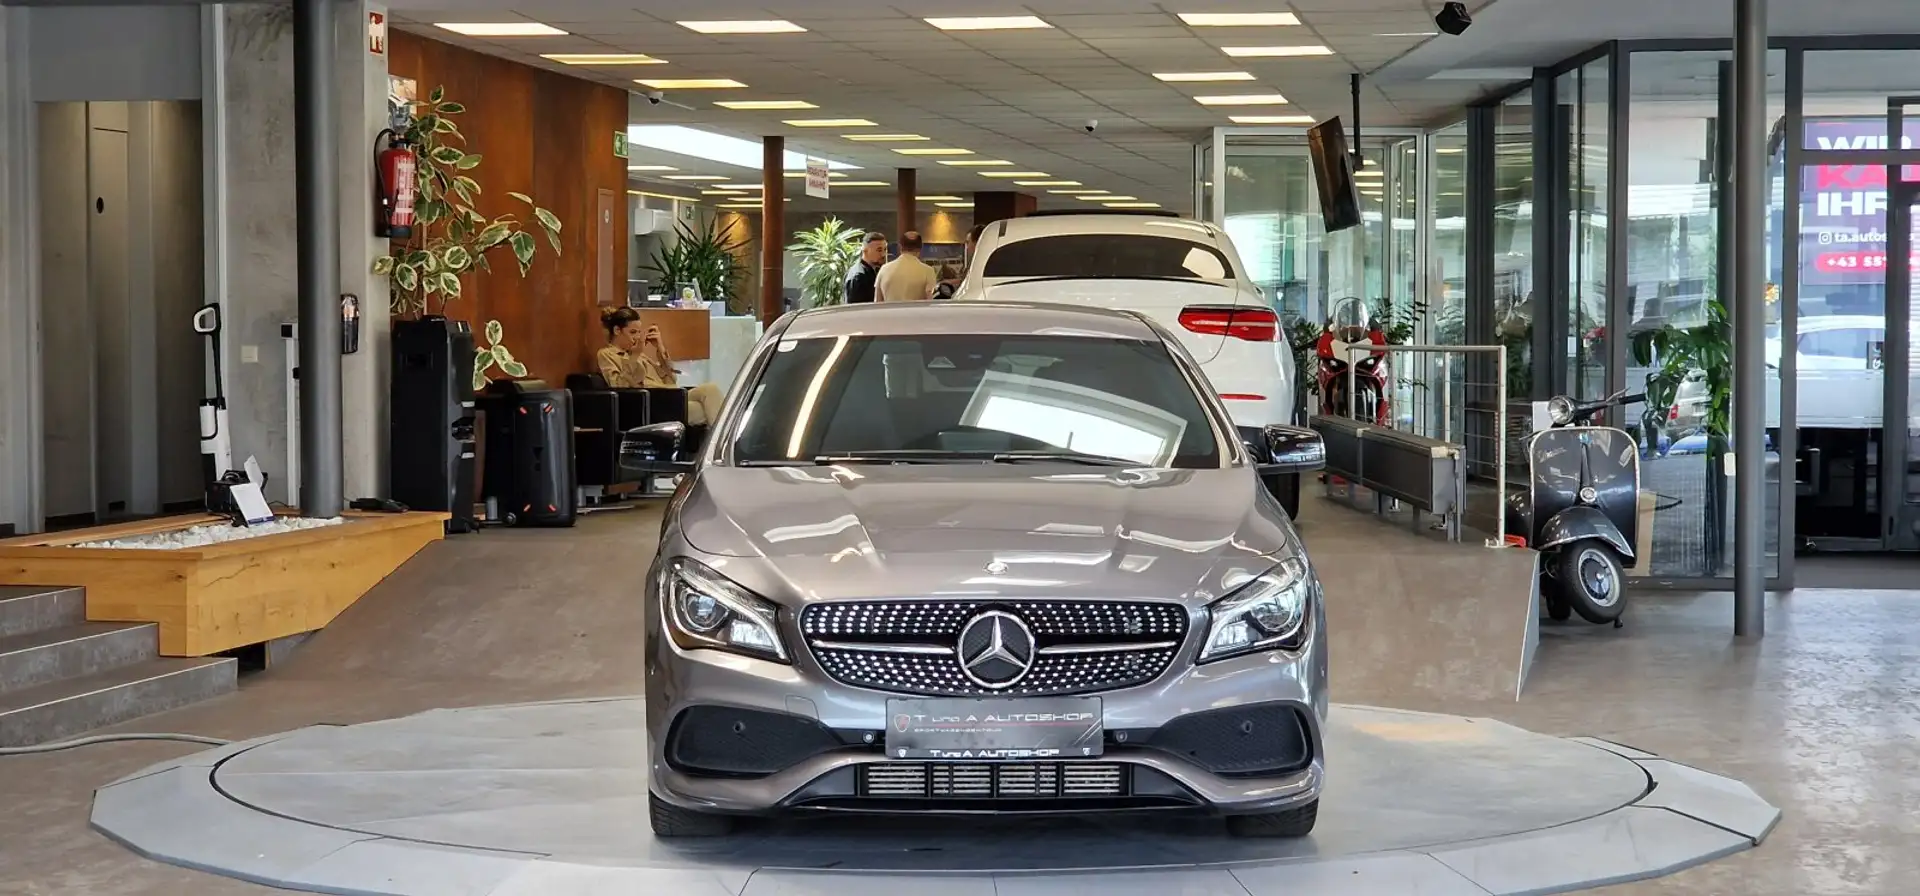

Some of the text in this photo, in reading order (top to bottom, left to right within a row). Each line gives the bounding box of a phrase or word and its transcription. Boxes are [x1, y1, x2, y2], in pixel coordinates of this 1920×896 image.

[965, 714, 978, 722] A
[983, 712, 1093, 722] AUTOSHOP
[978, 748, 1060, 758] AUTOSHOP
